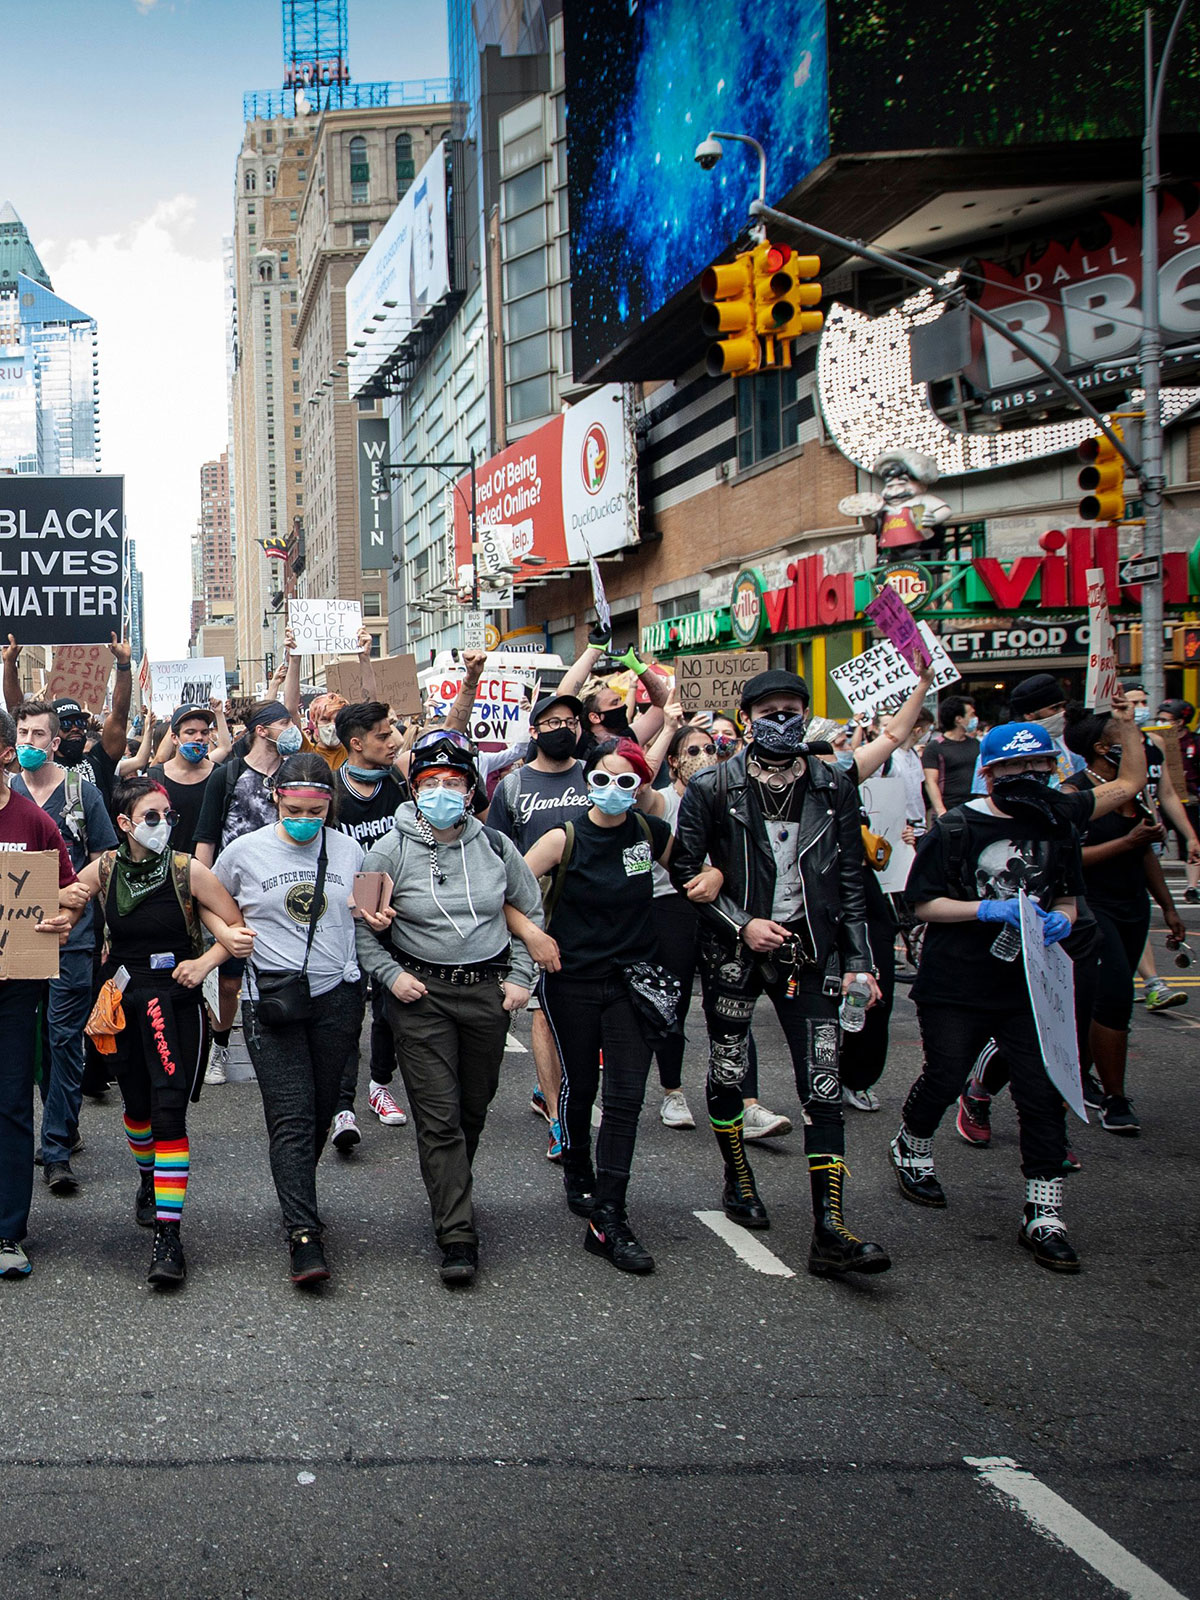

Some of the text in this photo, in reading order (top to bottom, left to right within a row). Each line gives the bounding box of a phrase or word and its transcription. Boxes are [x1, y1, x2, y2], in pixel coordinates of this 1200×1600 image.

[284, 60, 348, 82] HOTEL
[1024, 225, 1191, 292] DALLS
[991, 359, 1165, 412] RIBS HICKE
[471, 454, 537, 501] ired Of Being
[363, 441, 386, 546] WESTIN
[504, 477, 541, 518] Online?
[572, 498, 623, 530] DuckDuckGo
[480, 530, 511, 601] MORMN
[764, 554, 855, 635] villa
[290, 601, 360, 613] NO MORE
[733, 594, 759, 619] villa
[291, 613, 346, 627] RACIST
[642, 610, 717, 653] PIZZA SALADS
[292, 625, 345, 639] POLICE
[992, 627, 1067, 650] FOOD
[314, 638, 359, 652] TERRO
[503, 642, 545, 653] Auntie
[971, 645, 1062, 660] AT TIMES SQUARE
[157, 663, 189, 674] YOU STOP
[681, 657, 760, 677] NO JUSTICE
[832, 645, 888, 681] REFORM
[50, 676, 105, 704] COPS
[157, 673, 222, 692] STRING
[680, 679, 745, 699] NO PEAC
[848, 678, 885, 705] FUCK
[434, 703, 519, 722] RFORM
[704, 700, 729, 709] RACIST
[1012, 729, 1034, 742] Los
[519, 787, 592, 825] Yankees
[341, 815, 396, 841] WAKAND
[261, 870, 345, 893] HIGH TECH HIGH CHOOL
